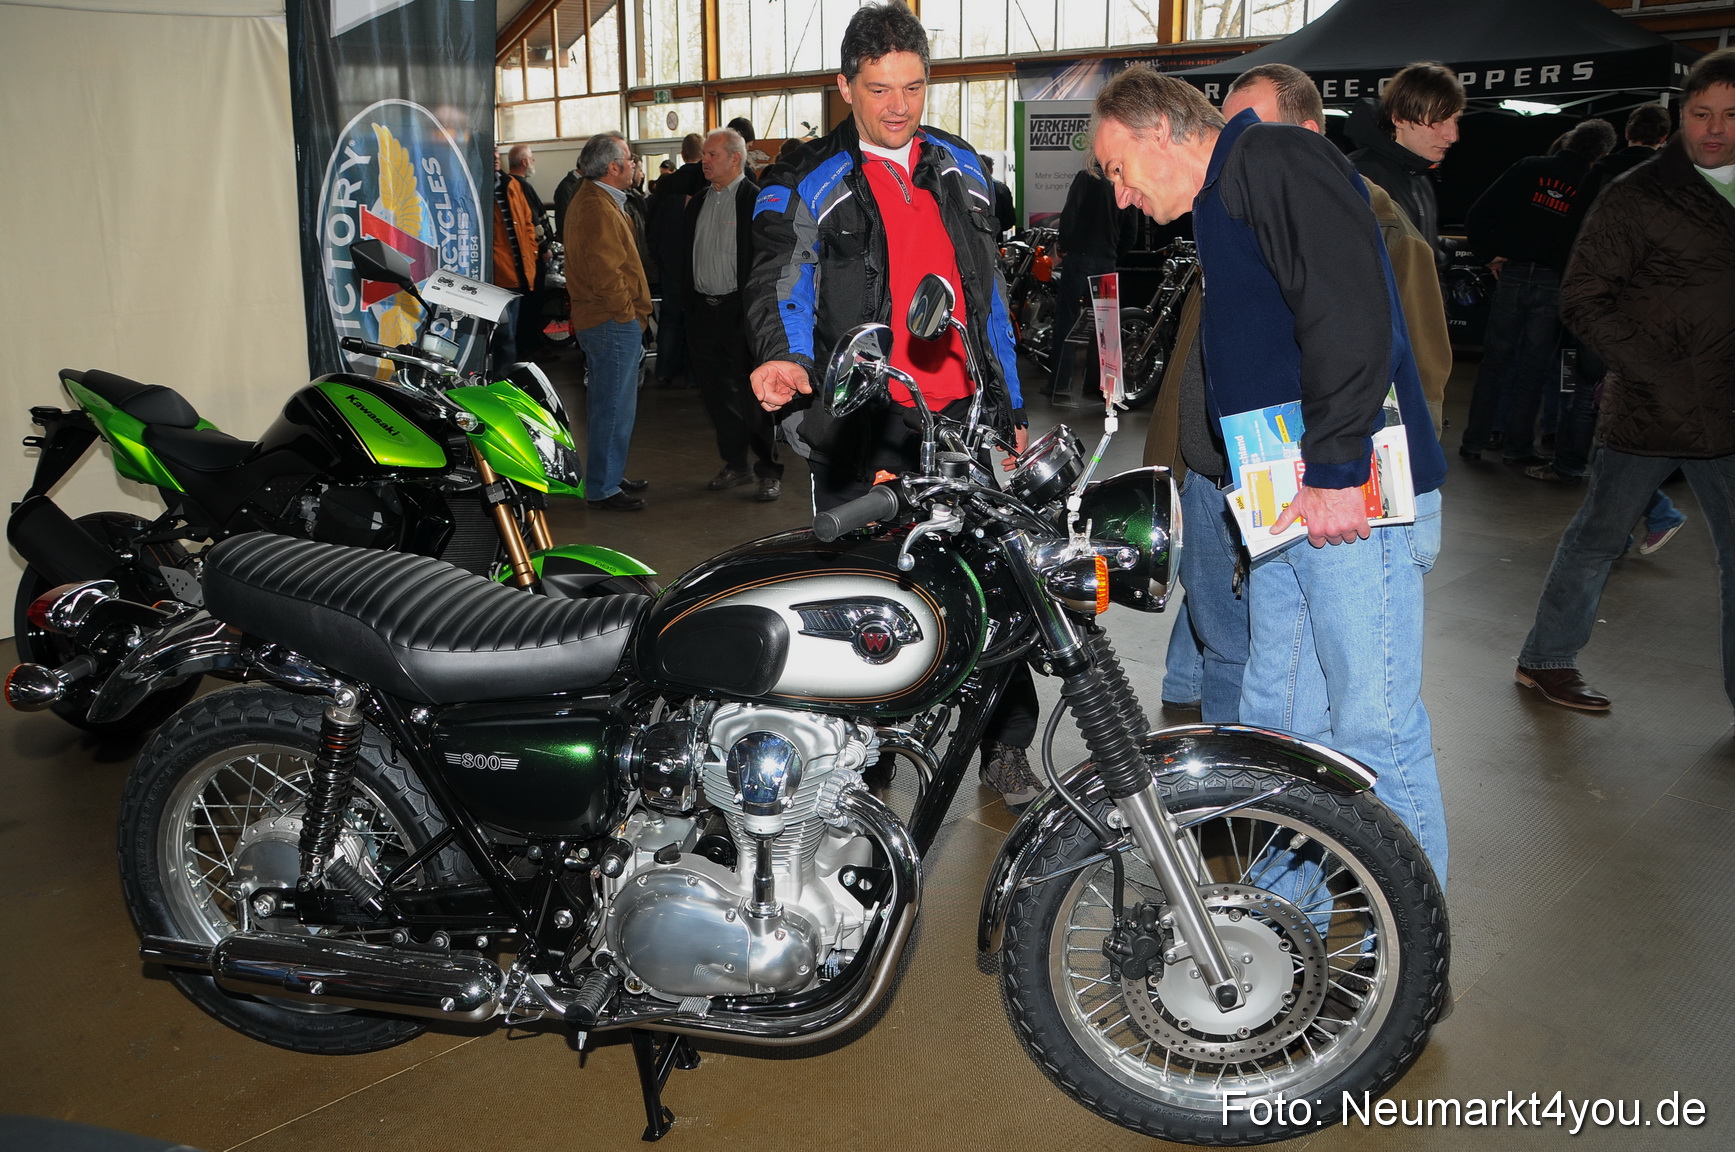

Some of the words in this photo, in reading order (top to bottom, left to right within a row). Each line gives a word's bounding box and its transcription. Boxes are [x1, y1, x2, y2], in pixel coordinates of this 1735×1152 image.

[1030, 133, 1073, 145] WACHT
[1035, 172, 1052, 180] Mehr
[1045, 183, 1064, 191] junge
[325, 145, 373, 346] ICTORY
[470, 235, 479, 264] 1954
[345, 394, 401, 436] Kawasaki
[861, 631, 889, 651] W
[461, 752, 501, 771] 800
